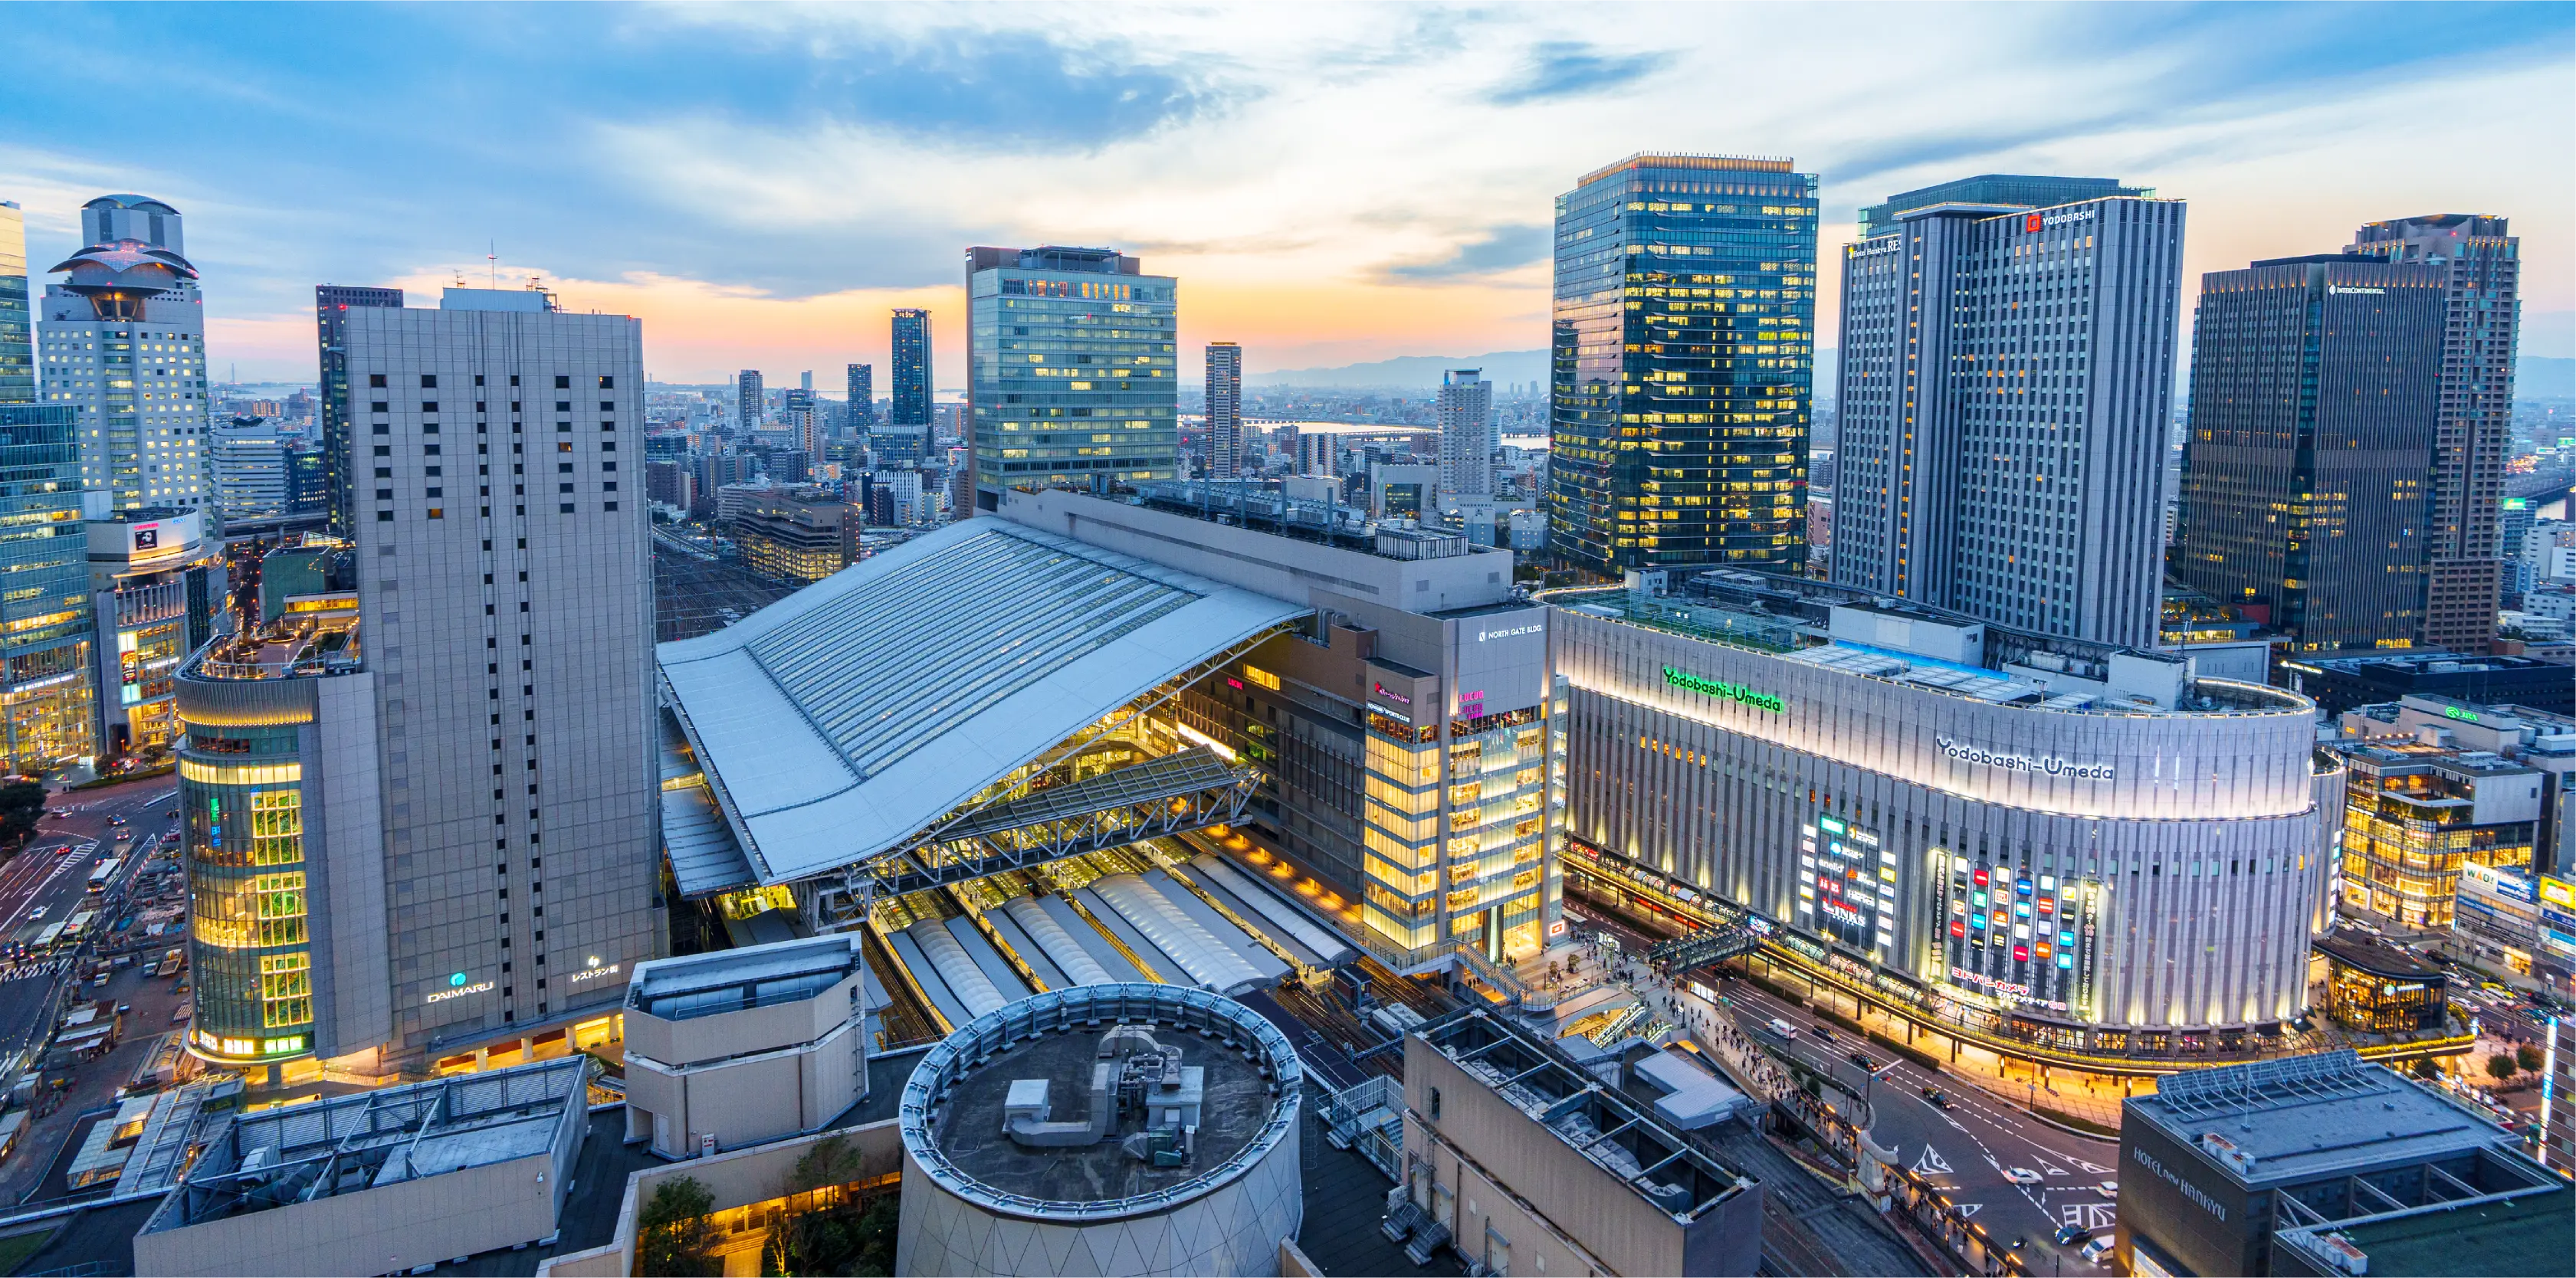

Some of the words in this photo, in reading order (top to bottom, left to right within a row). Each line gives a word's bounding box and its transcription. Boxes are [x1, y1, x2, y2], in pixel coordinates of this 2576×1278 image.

[2043, 209, 2095, 226] YODOBASHI
[1852, 249, 1866, 257] Hotel
[1866, 246, 1887, 256] Hankyu
[1488, 628, 1509, 640] NORTH
[1510, 627, 1525, 636] GATE
[1663, 668, 1780, 712] Yodobashi-Umeda
[1936, 738, 2114, 780] Yodobashi-Umeda
[2467, 869, 2494, 884] WAO!
[428, 981, 494, 1003] DAIMARU
[1951, 967, 2030, 995] ヨドバシカメラ
[2134, 1147, 2162, 1178] HOTEL
[2163, 1169, 2179, 1187] new
[2181, 1179, 2226, 1221] HANKYU
